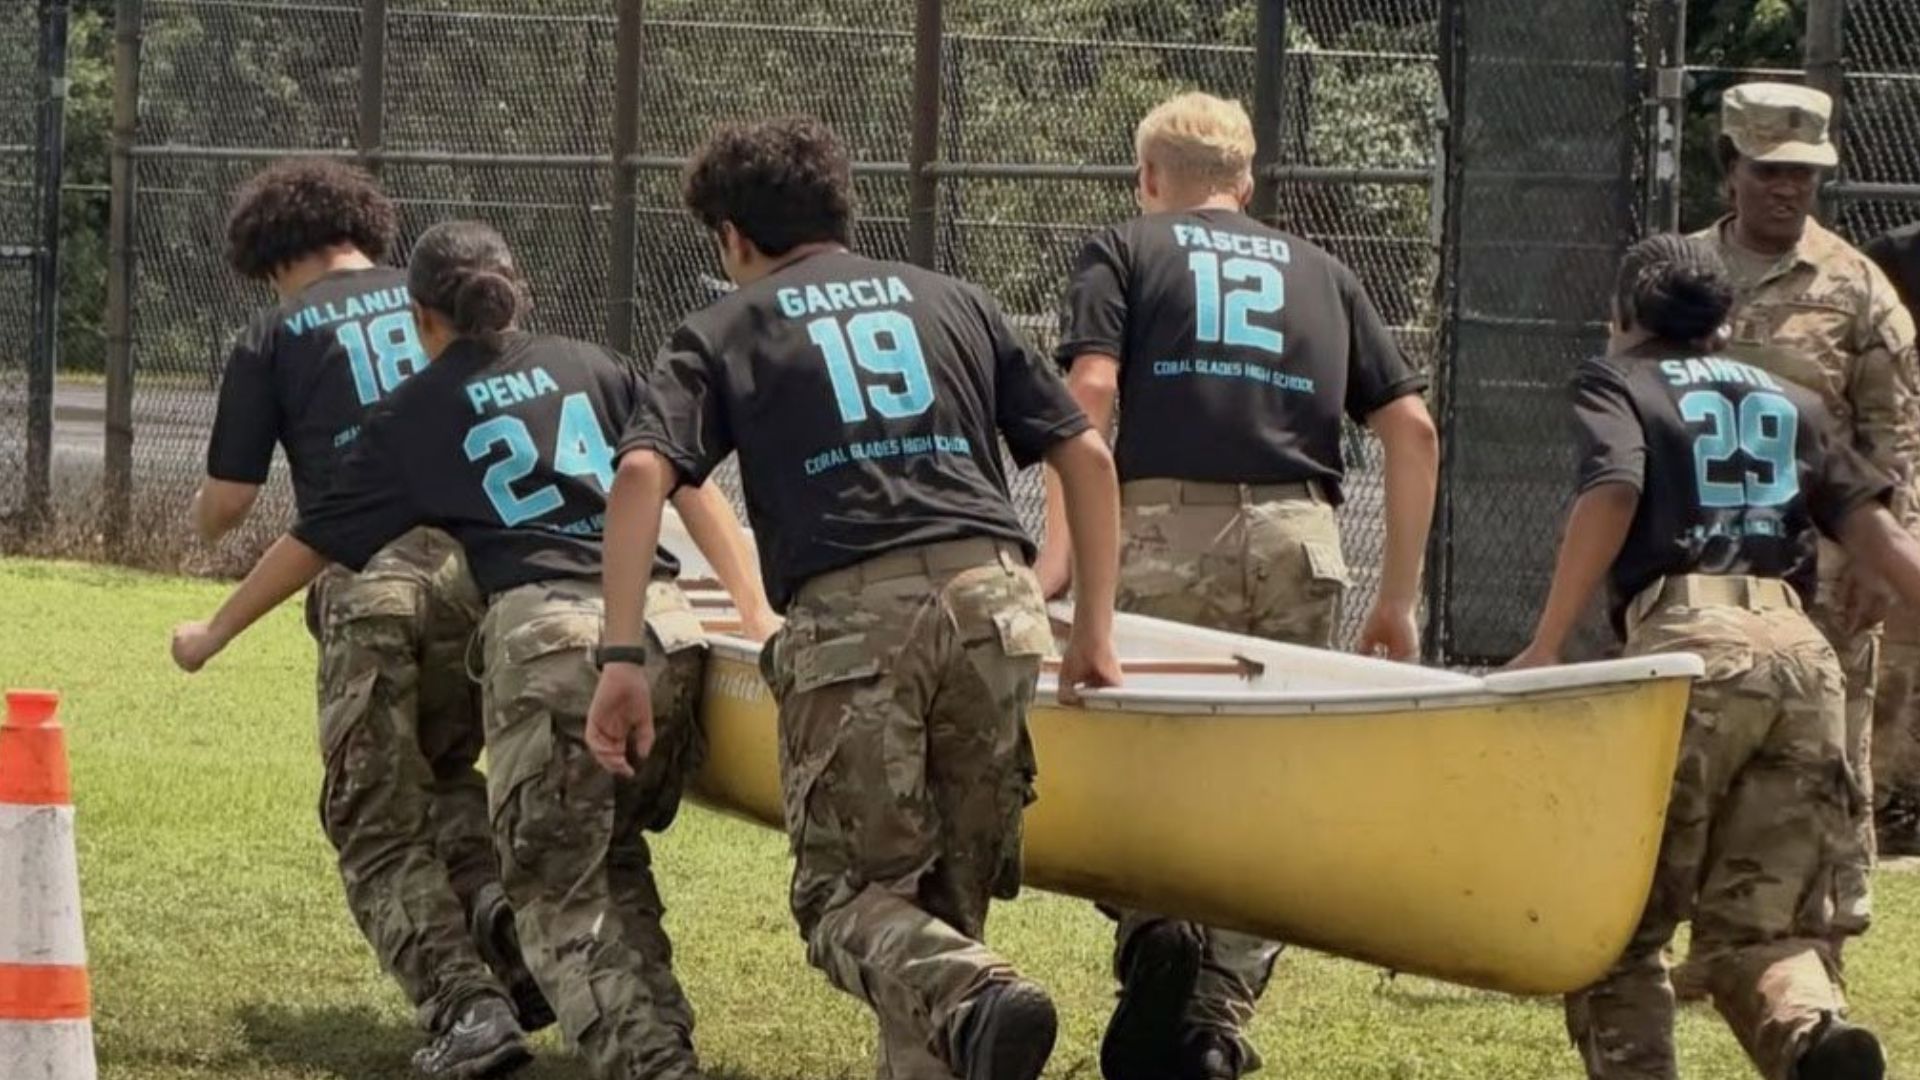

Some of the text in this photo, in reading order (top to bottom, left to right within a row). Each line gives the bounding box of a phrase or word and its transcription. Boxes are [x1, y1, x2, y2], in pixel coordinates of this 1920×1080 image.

[776, 276, 914, 318] GARCIA
[1188, 251, 1285, 354] 12
[337, 311, 429, 405] 18
[465, 366, 558, 414] PENA
[807, 310, 935, 423] 19
[1153, 360, 1316, 394] CORAL GLADES HIGH SCHOOL
[462, 392, 616, 527] 24
[804, 446, 848, 475] CORAL
[850, 438, 900, 459] GLADES
[903, 435, 932, 454] HIGH
[1679, 390, 1799, 507] 29
